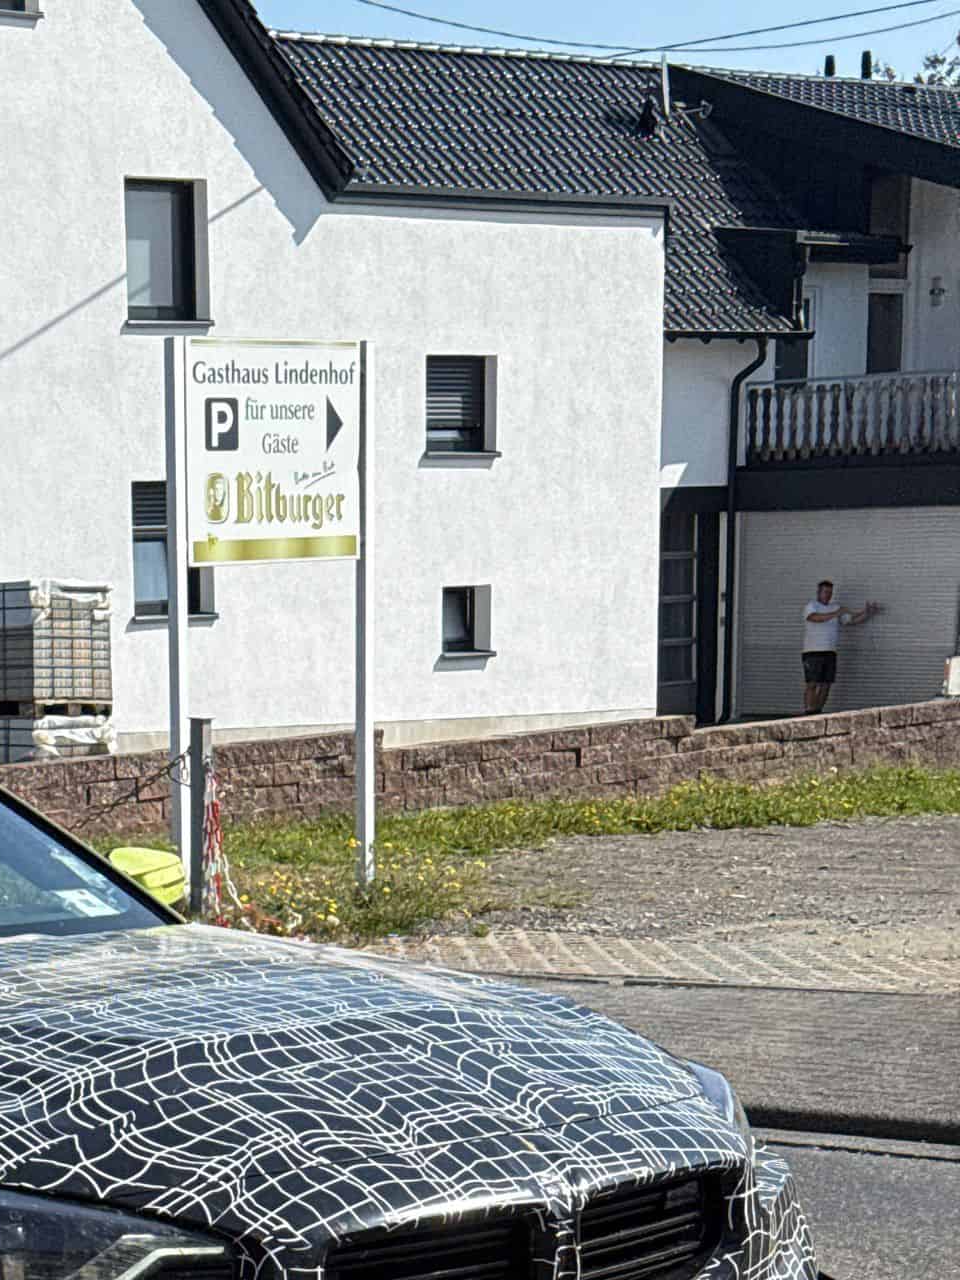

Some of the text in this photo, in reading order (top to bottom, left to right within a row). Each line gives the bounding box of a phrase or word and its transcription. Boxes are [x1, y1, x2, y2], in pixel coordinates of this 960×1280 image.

[192, 360, 356, 385] Gasthaus Lindenhof
[209, 397, 315, 449] P für unsere
[262, 433, 299, 454] Gäste
[234, 471, 346, 530] Bitburger
